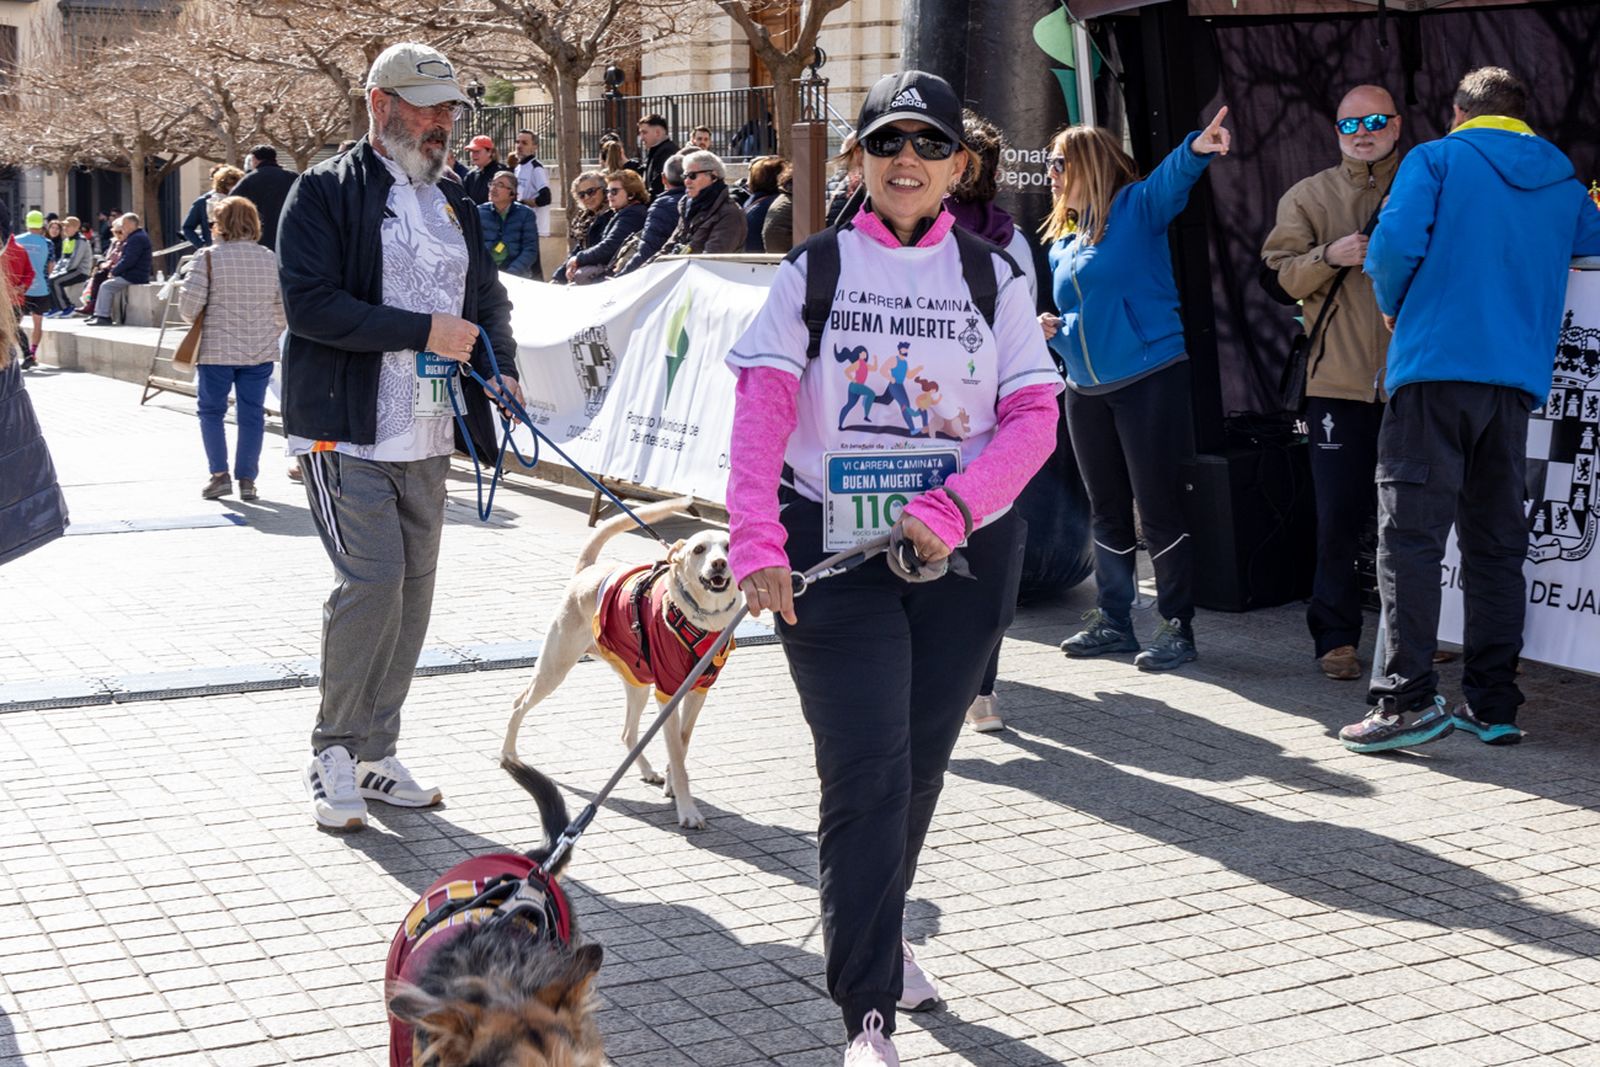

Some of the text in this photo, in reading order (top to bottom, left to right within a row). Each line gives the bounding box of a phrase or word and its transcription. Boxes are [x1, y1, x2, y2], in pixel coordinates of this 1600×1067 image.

[891, 98, 927, 109] adidas
[848, 291, 912, 309] CARRERA
[916, 297, 979, 315] CAMINA
[830, 310, 956, 340] BUENA MUERTE
[431, 379, 448, 402] 11
[842, 458, 944, 470] VI CARRERA CAMINATA
[842, 473, 923, 489] BUENA MUERTE
[1529, 580, 1563, 608] DE
